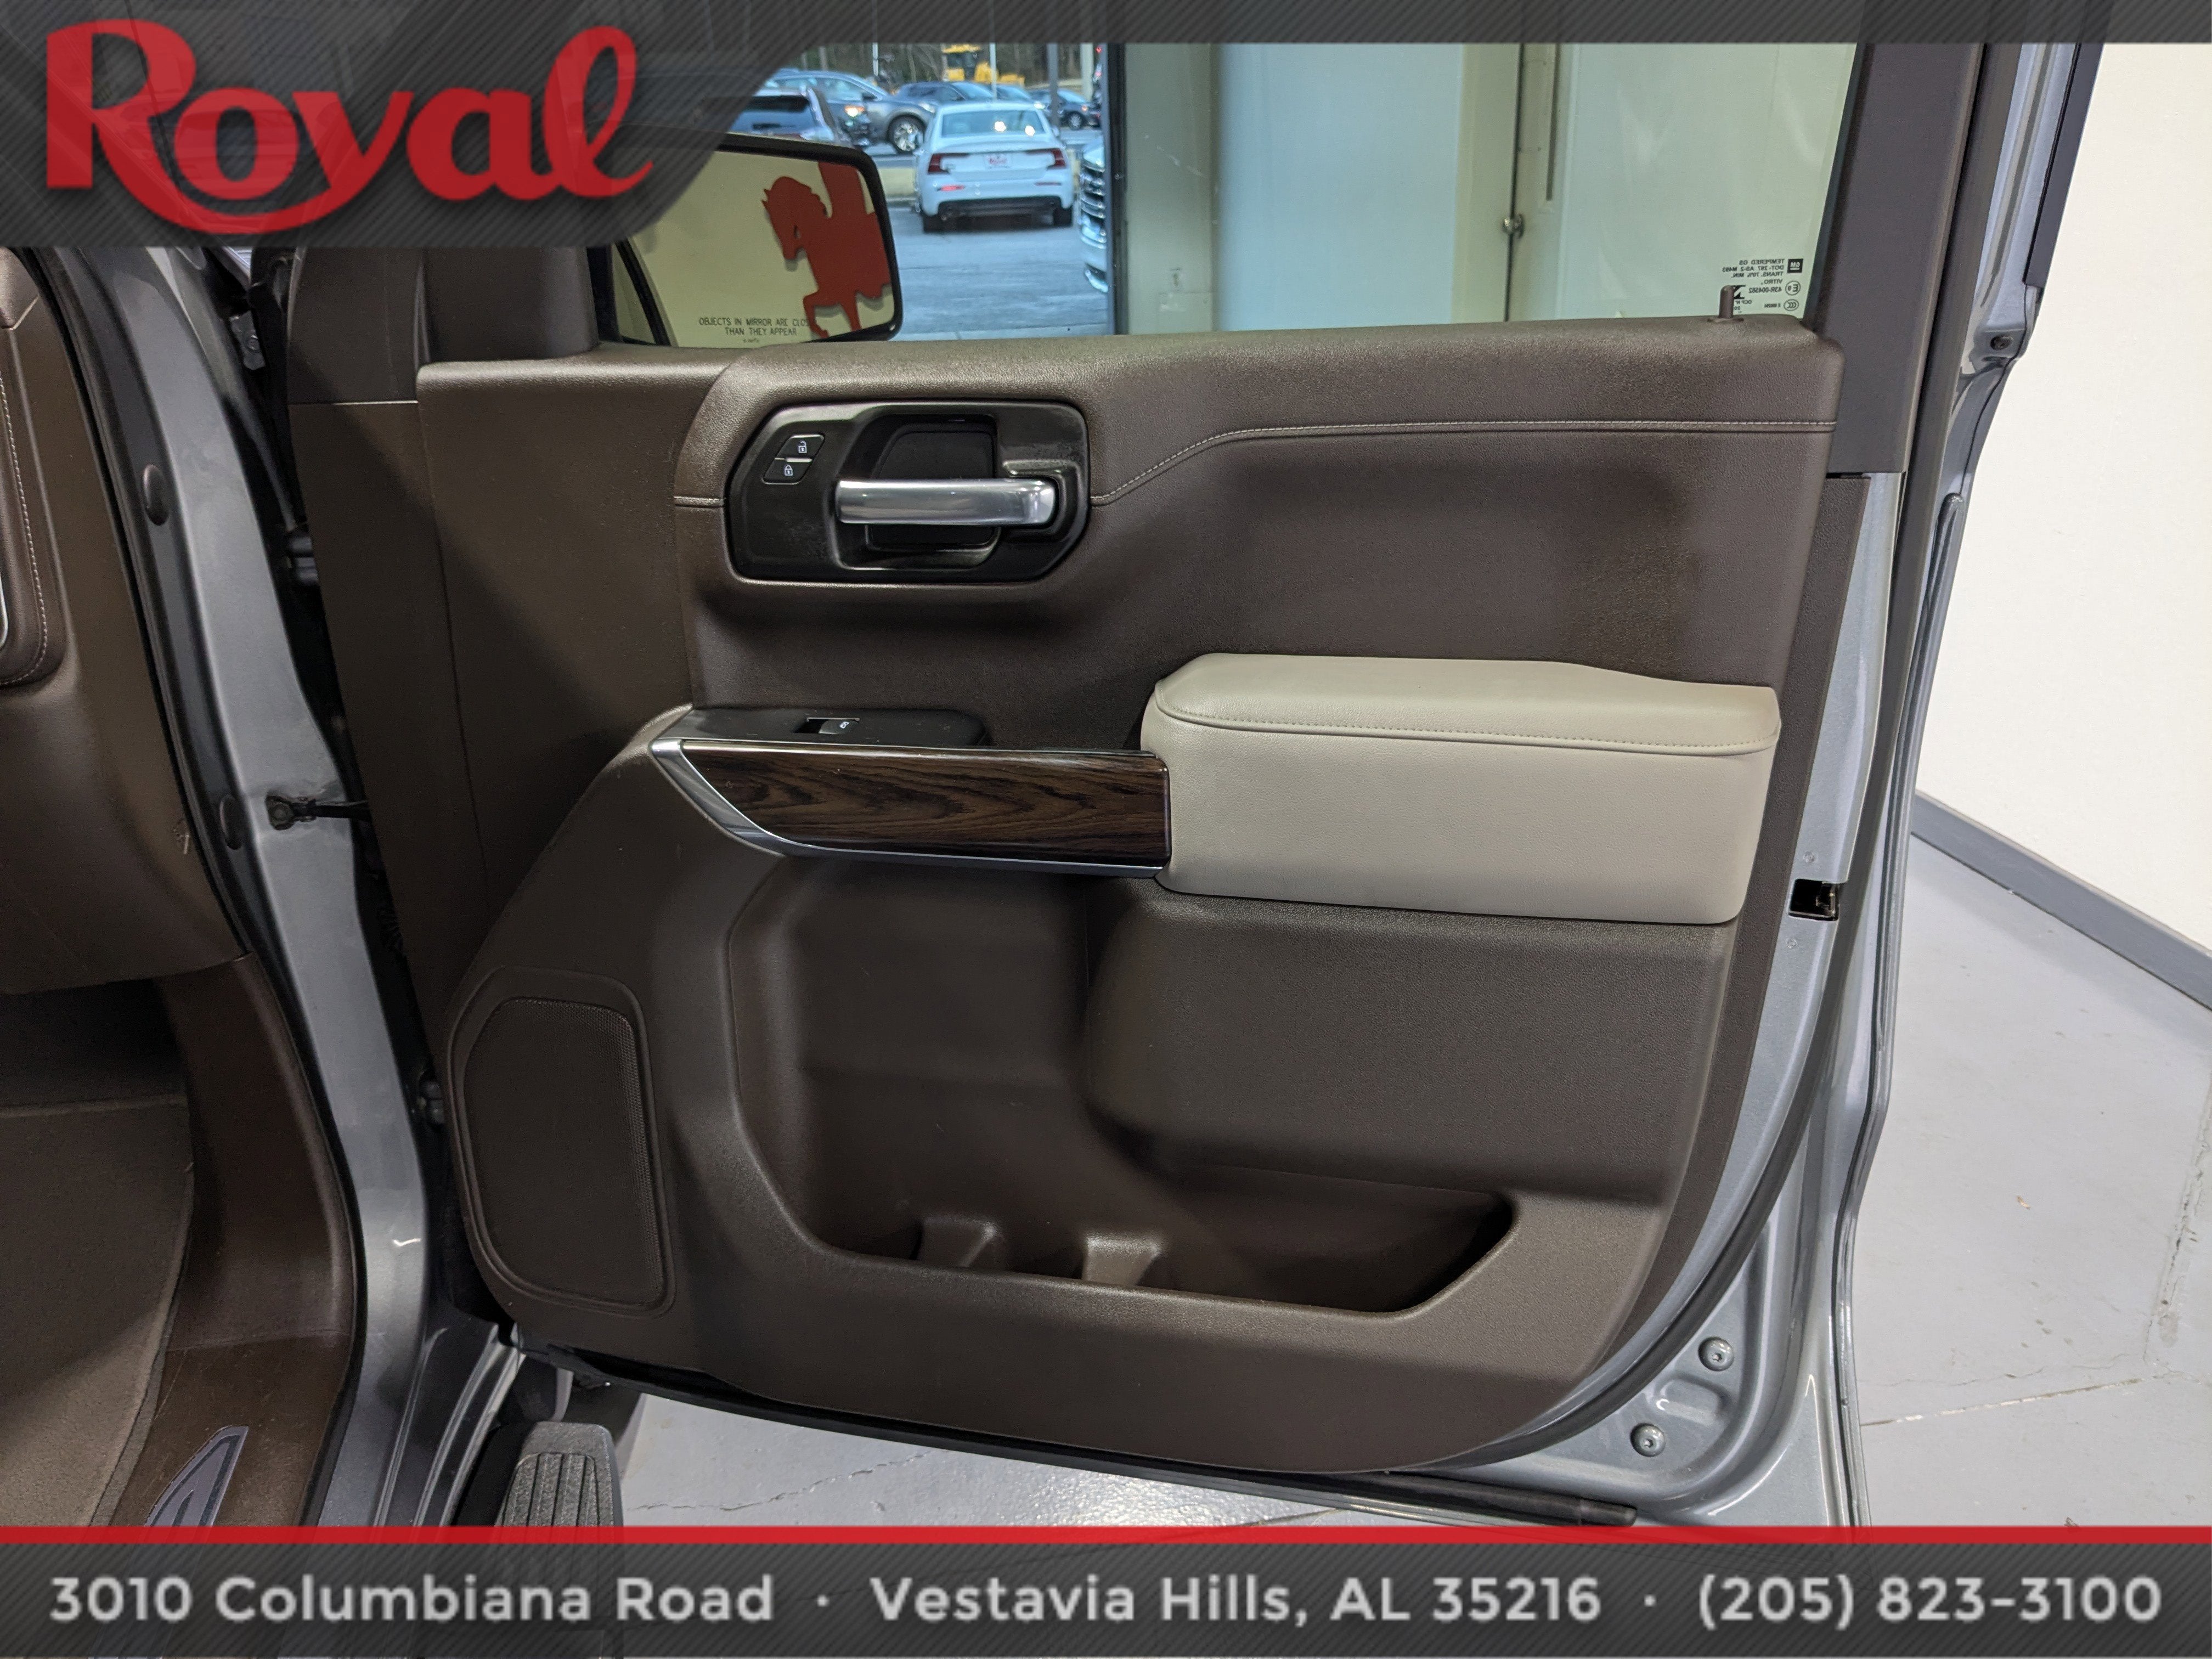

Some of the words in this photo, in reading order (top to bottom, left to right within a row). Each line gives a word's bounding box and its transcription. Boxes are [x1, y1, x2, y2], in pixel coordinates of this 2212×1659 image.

[698, 317, 732, 326] OBJECTS
[745, 318, 772, 326] MIRROR
[776, 318, 788, 327] ARE
[725, 326, 744, 335] THAN
[748, 327, 766, 335] THEY
[770, 328, 797, 336] APPEAR
